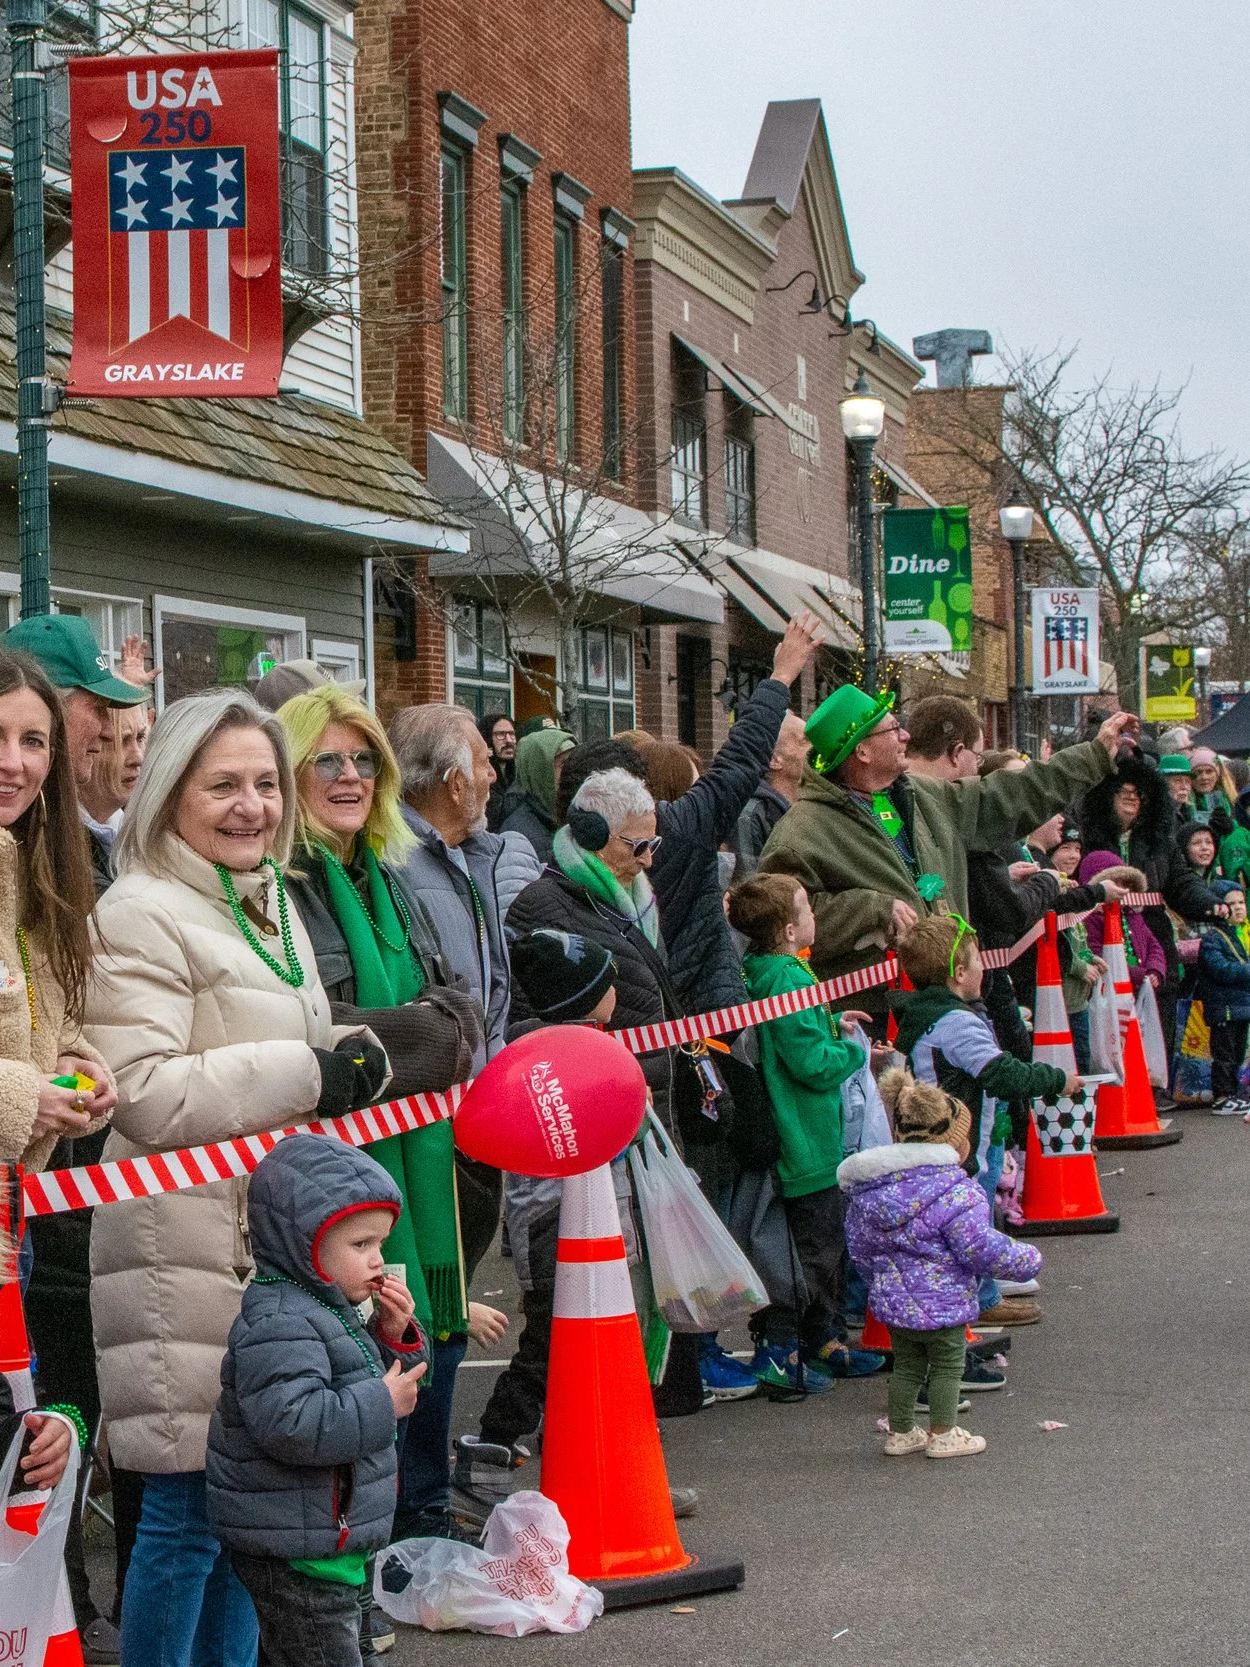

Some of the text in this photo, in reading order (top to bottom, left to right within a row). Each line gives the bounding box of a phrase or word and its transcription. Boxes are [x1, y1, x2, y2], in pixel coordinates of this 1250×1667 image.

[127, 67, 223, 109] USA
[139, 110, 211, 144] 250
[104, 362, 245, 383] GRAYSLAKE
[888, 554, 950, 574] Dine
[891, 598, 921, 607] center
[1051, 593, 1080, 605] USA
[889, 605, 924, 617] yourself
[1054, 605, 1078, 616] 250
[537, 1093, 565, 1160] Services
[546, 1078, 579, 1157] McMahon
